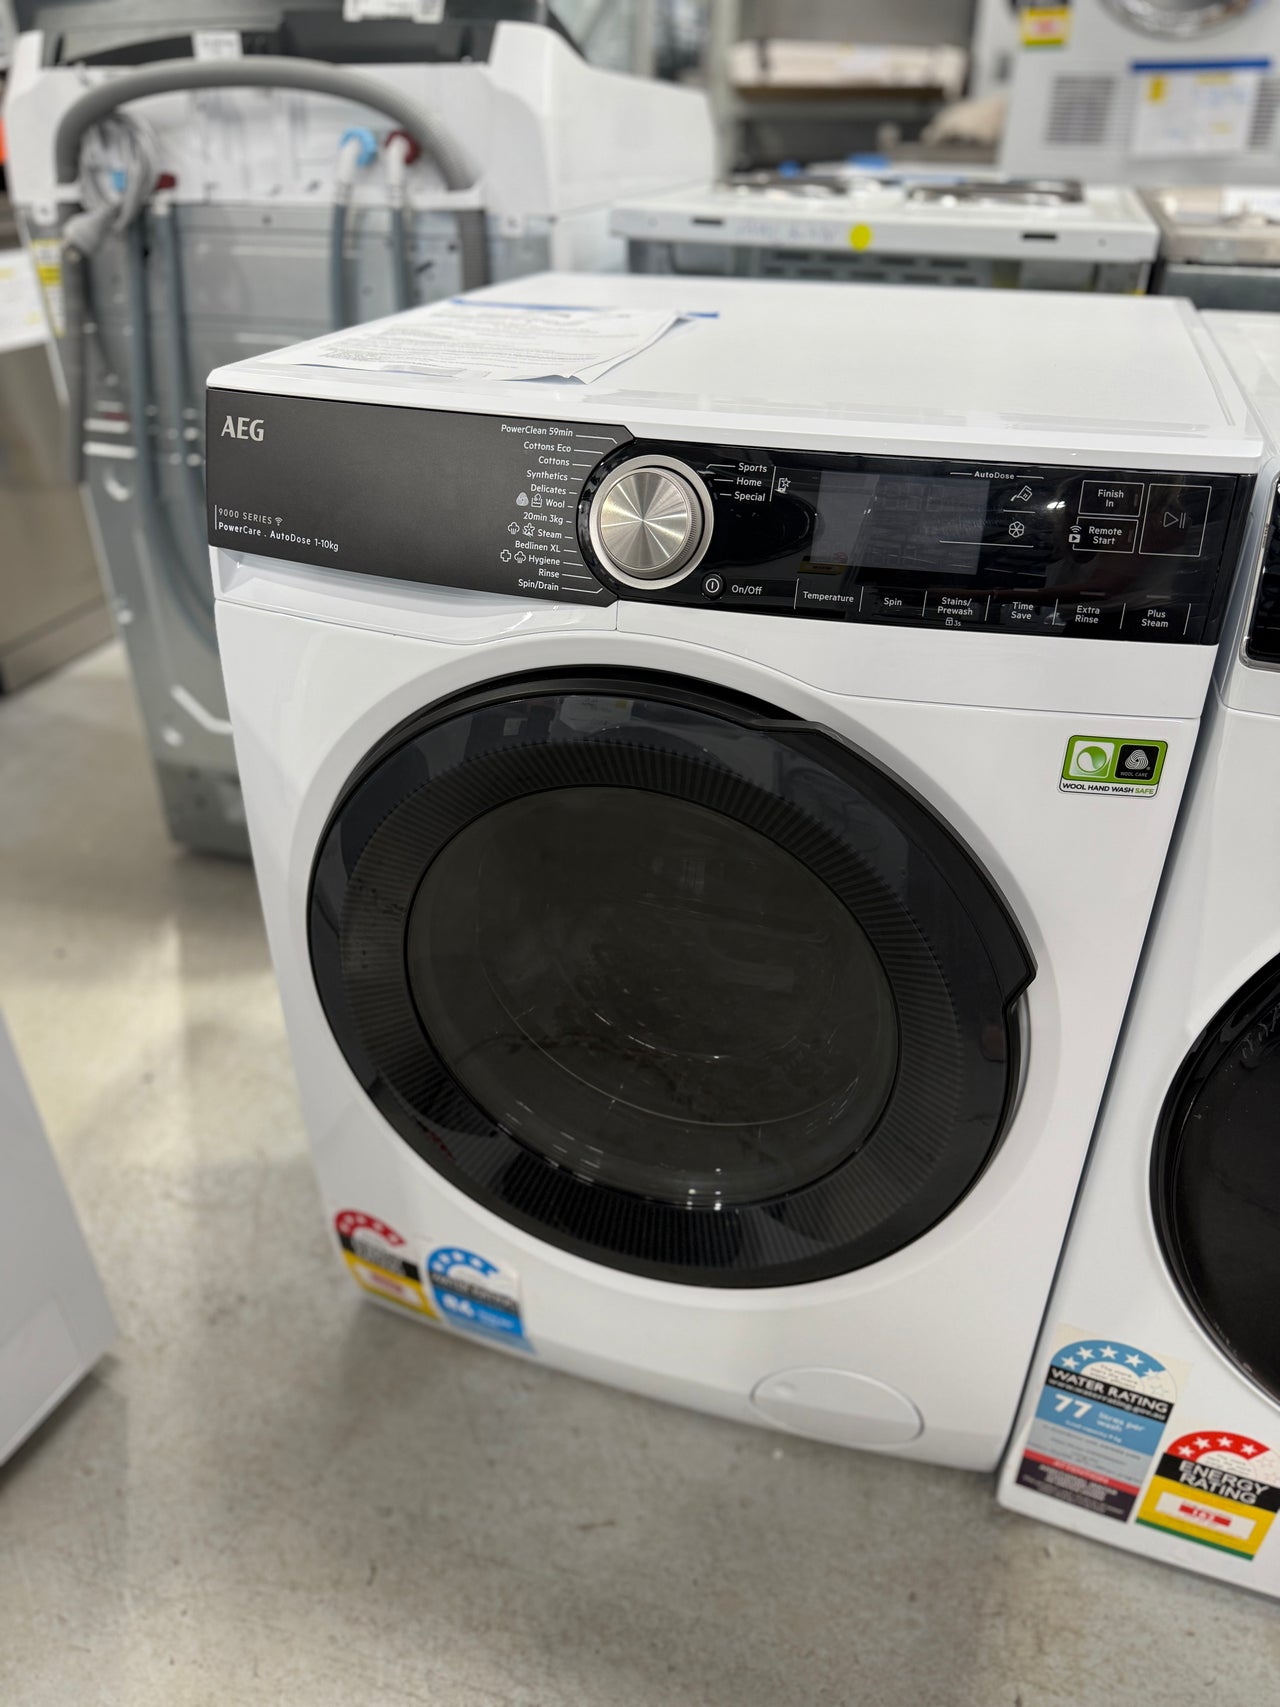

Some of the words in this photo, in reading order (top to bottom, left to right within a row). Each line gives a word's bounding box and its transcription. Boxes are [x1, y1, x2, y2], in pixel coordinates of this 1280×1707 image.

[221, 415, 265, 441] AEG
[501, 424, 547, 435] PowerClean
[548, 427, 573, 437] 59min
[523, 441, 555, 451] Cottons
[557, 443, 572, 452] Eco
[538, 456, 570, 466] Cottons
[738, 462, 768, 473] Sports
[526, 469, 568, 481] Synthetics
[974, 471, 1015, 480] AutoDose
[736, 477, 762, 487] Home
[531, 484, 567, 495] Delicates
[1097, 489, 1124, 499] Finish
[734, 491, 766, 502] Special
[545, 498, 565, 509] Wool
[1105, 499, 1114, 508] In
[218, 508, 239, 519] 9000
[242, 512, 272, 525] SERIES
[523, 511, 548, 522] 20min
[549, 514, 564, 526] 3kg
[537, 528, 562, 539] Steam
[1088, 526, 1123, 536] Remote
[218, 521, 262, 536] PowerCare
[270, 530, 311, 546] AutoDose
[314, 538, 339, 553] 1-10kg
[1092, 536, 1115, 545] Start
[515, 540, 548, 551] Bedlinen
[550, 544, 561, 553] XL
[528, 554, 560, 566] Hygiene
[538, 568, 560, 579] Rinse
[518, 578, 559, 591] Spin/Drain
[731, 584, 762, 595] On/Off
[803, 591, 854, 603] Temperature
[884, 597, 902, 607] Spin
[941, 597, 972, 607] Stains/
[937, 606, 973, 616] Prewash
[1012, 602, 1034, 611] Time
[1076, 605, 1100, 615] Extra
[1010, 611, 1032, 620] Save
[1074, 614, 1099, 624] Rinse
[1147, 609, 1166, 618] Plus
[1141, 619, 1169, 628] Steam
[1062, 782, 1086, 791] WOOL
[1087, 784, 1110, 792] HAND
[1111, 785, 1134, 793] WASH
[1135, 787, 1155, 795] SAFE
[1051, 1367, 1105, 1394] WATER
[1107, 1386, 1169, 1414] RATING
[1054, 1393, 1093, 1419] 77
[1179, 1459, 1269, 1495] ENERGY
[1179, 1472, 1257, 1505] RATING
